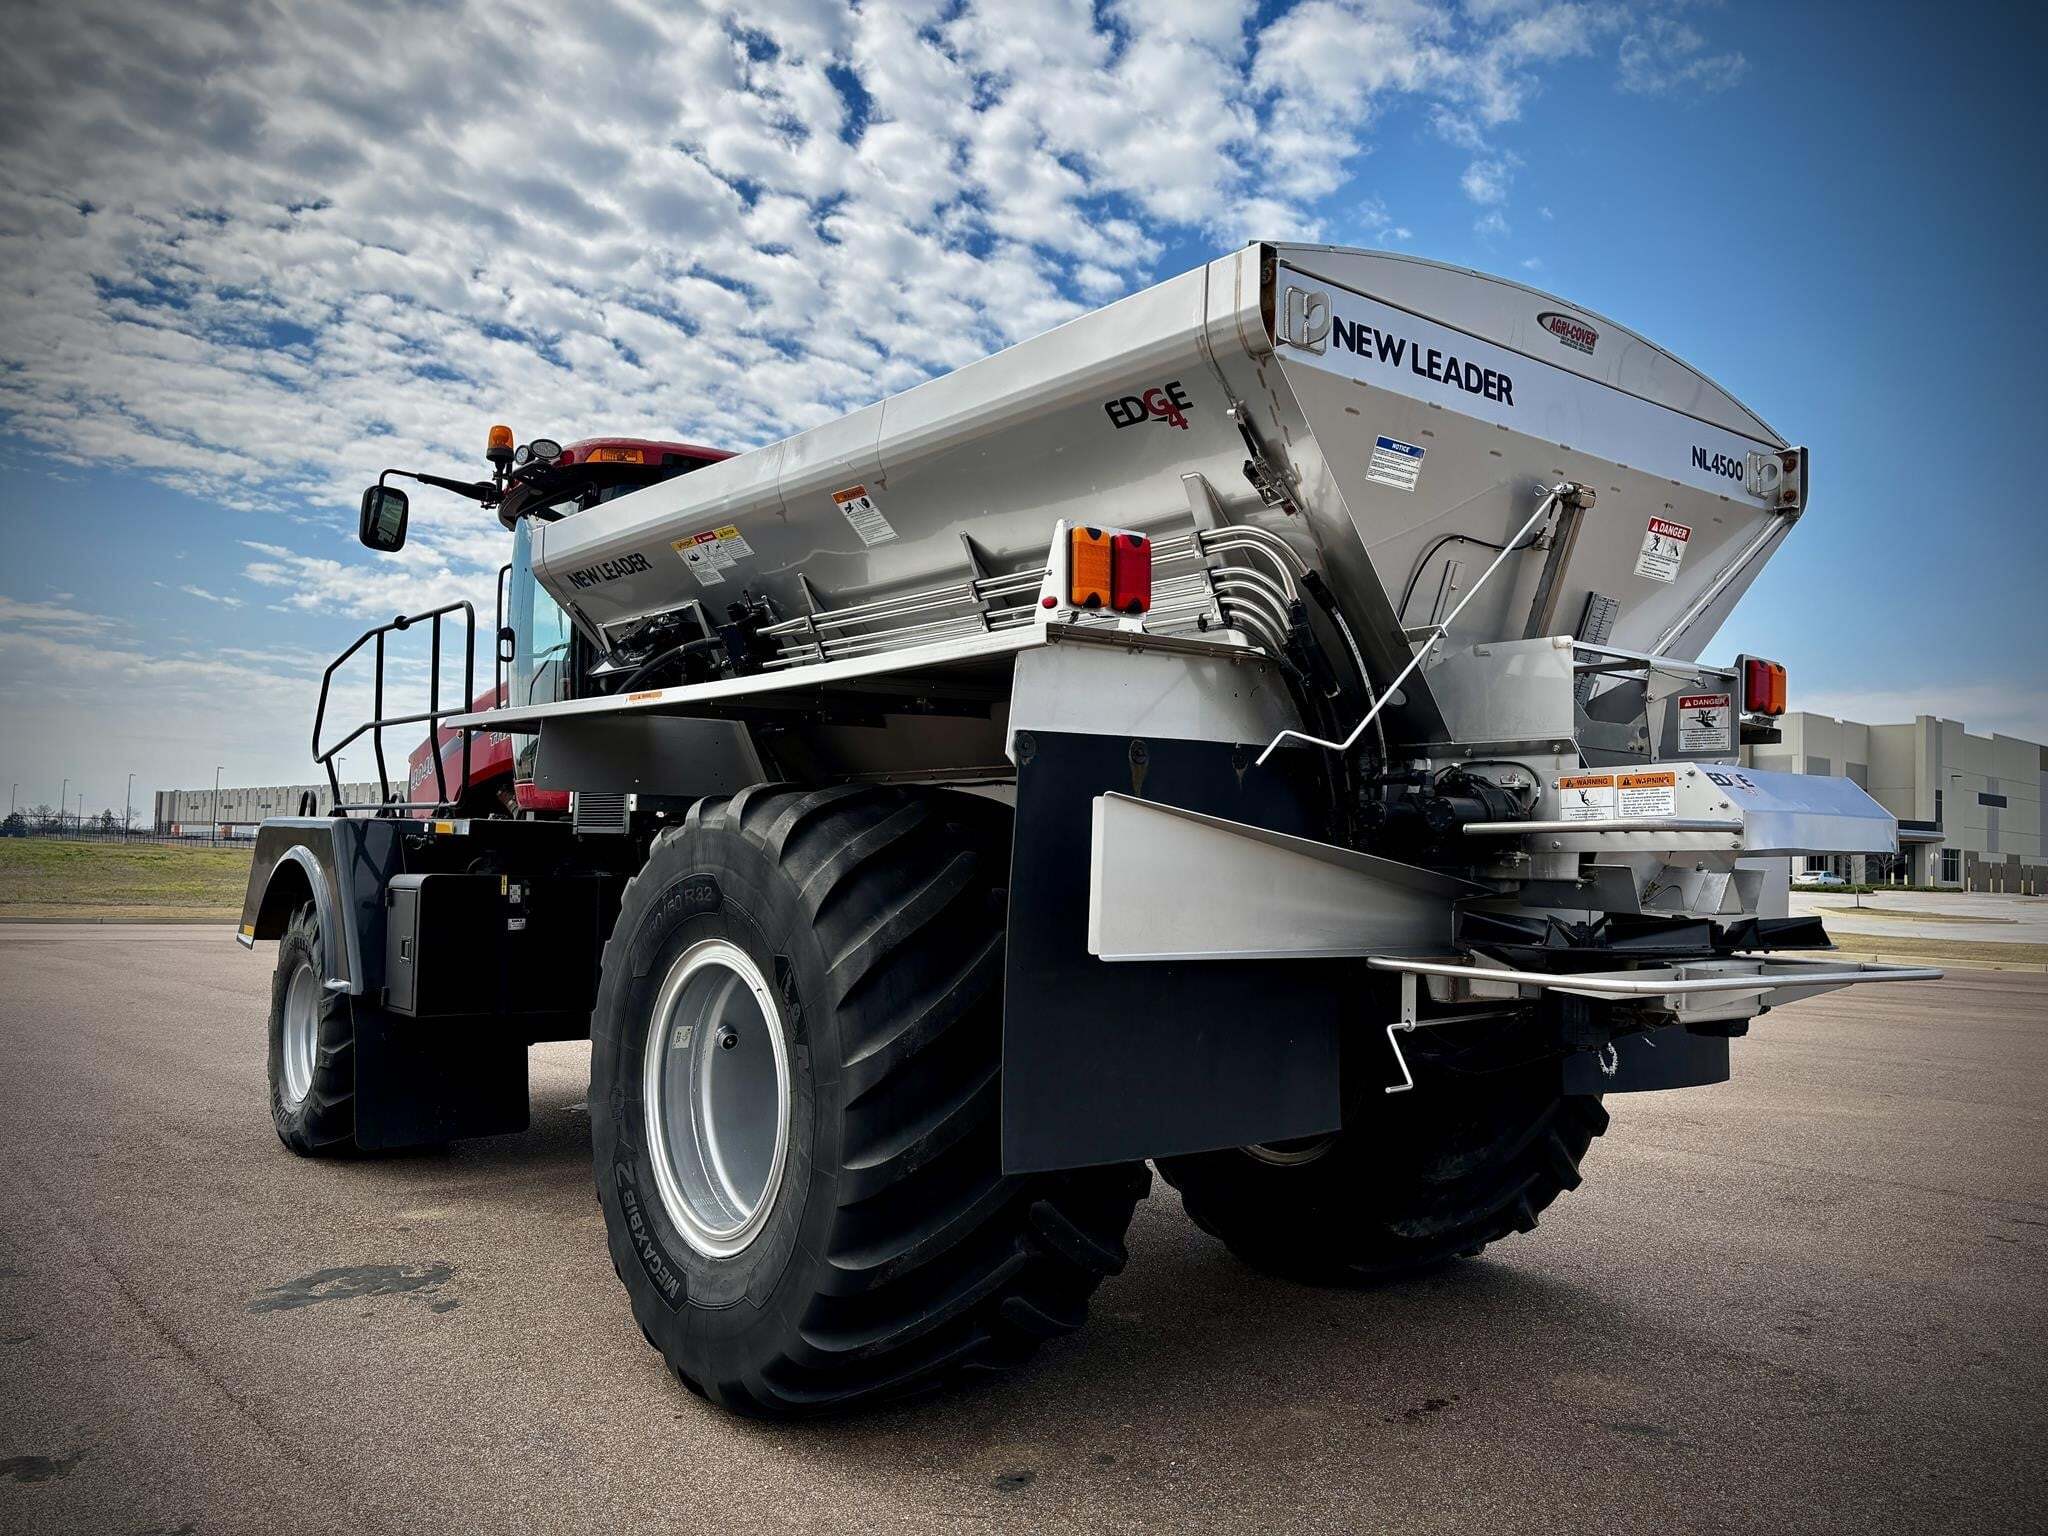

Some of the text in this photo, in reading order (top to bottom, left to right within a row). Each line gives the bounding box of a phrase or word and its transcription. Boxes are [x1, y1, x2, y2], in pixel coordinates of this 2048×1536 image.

[1550, 317, 1597, 347] AGRI-COVER
[1333, 316, 1514, 406] NEW LEADER
[1692, 445, 1743, 481] NL4500
[1659, 522, 1687, 539] DANGER
[566, 552, 653, 590] NEW LEADER
[1576, 778, 1608, 786] WARNING
[1635, 776, 1670, 785] WARNING
[623, 1190, 681, 1299] MEGAXBIB
